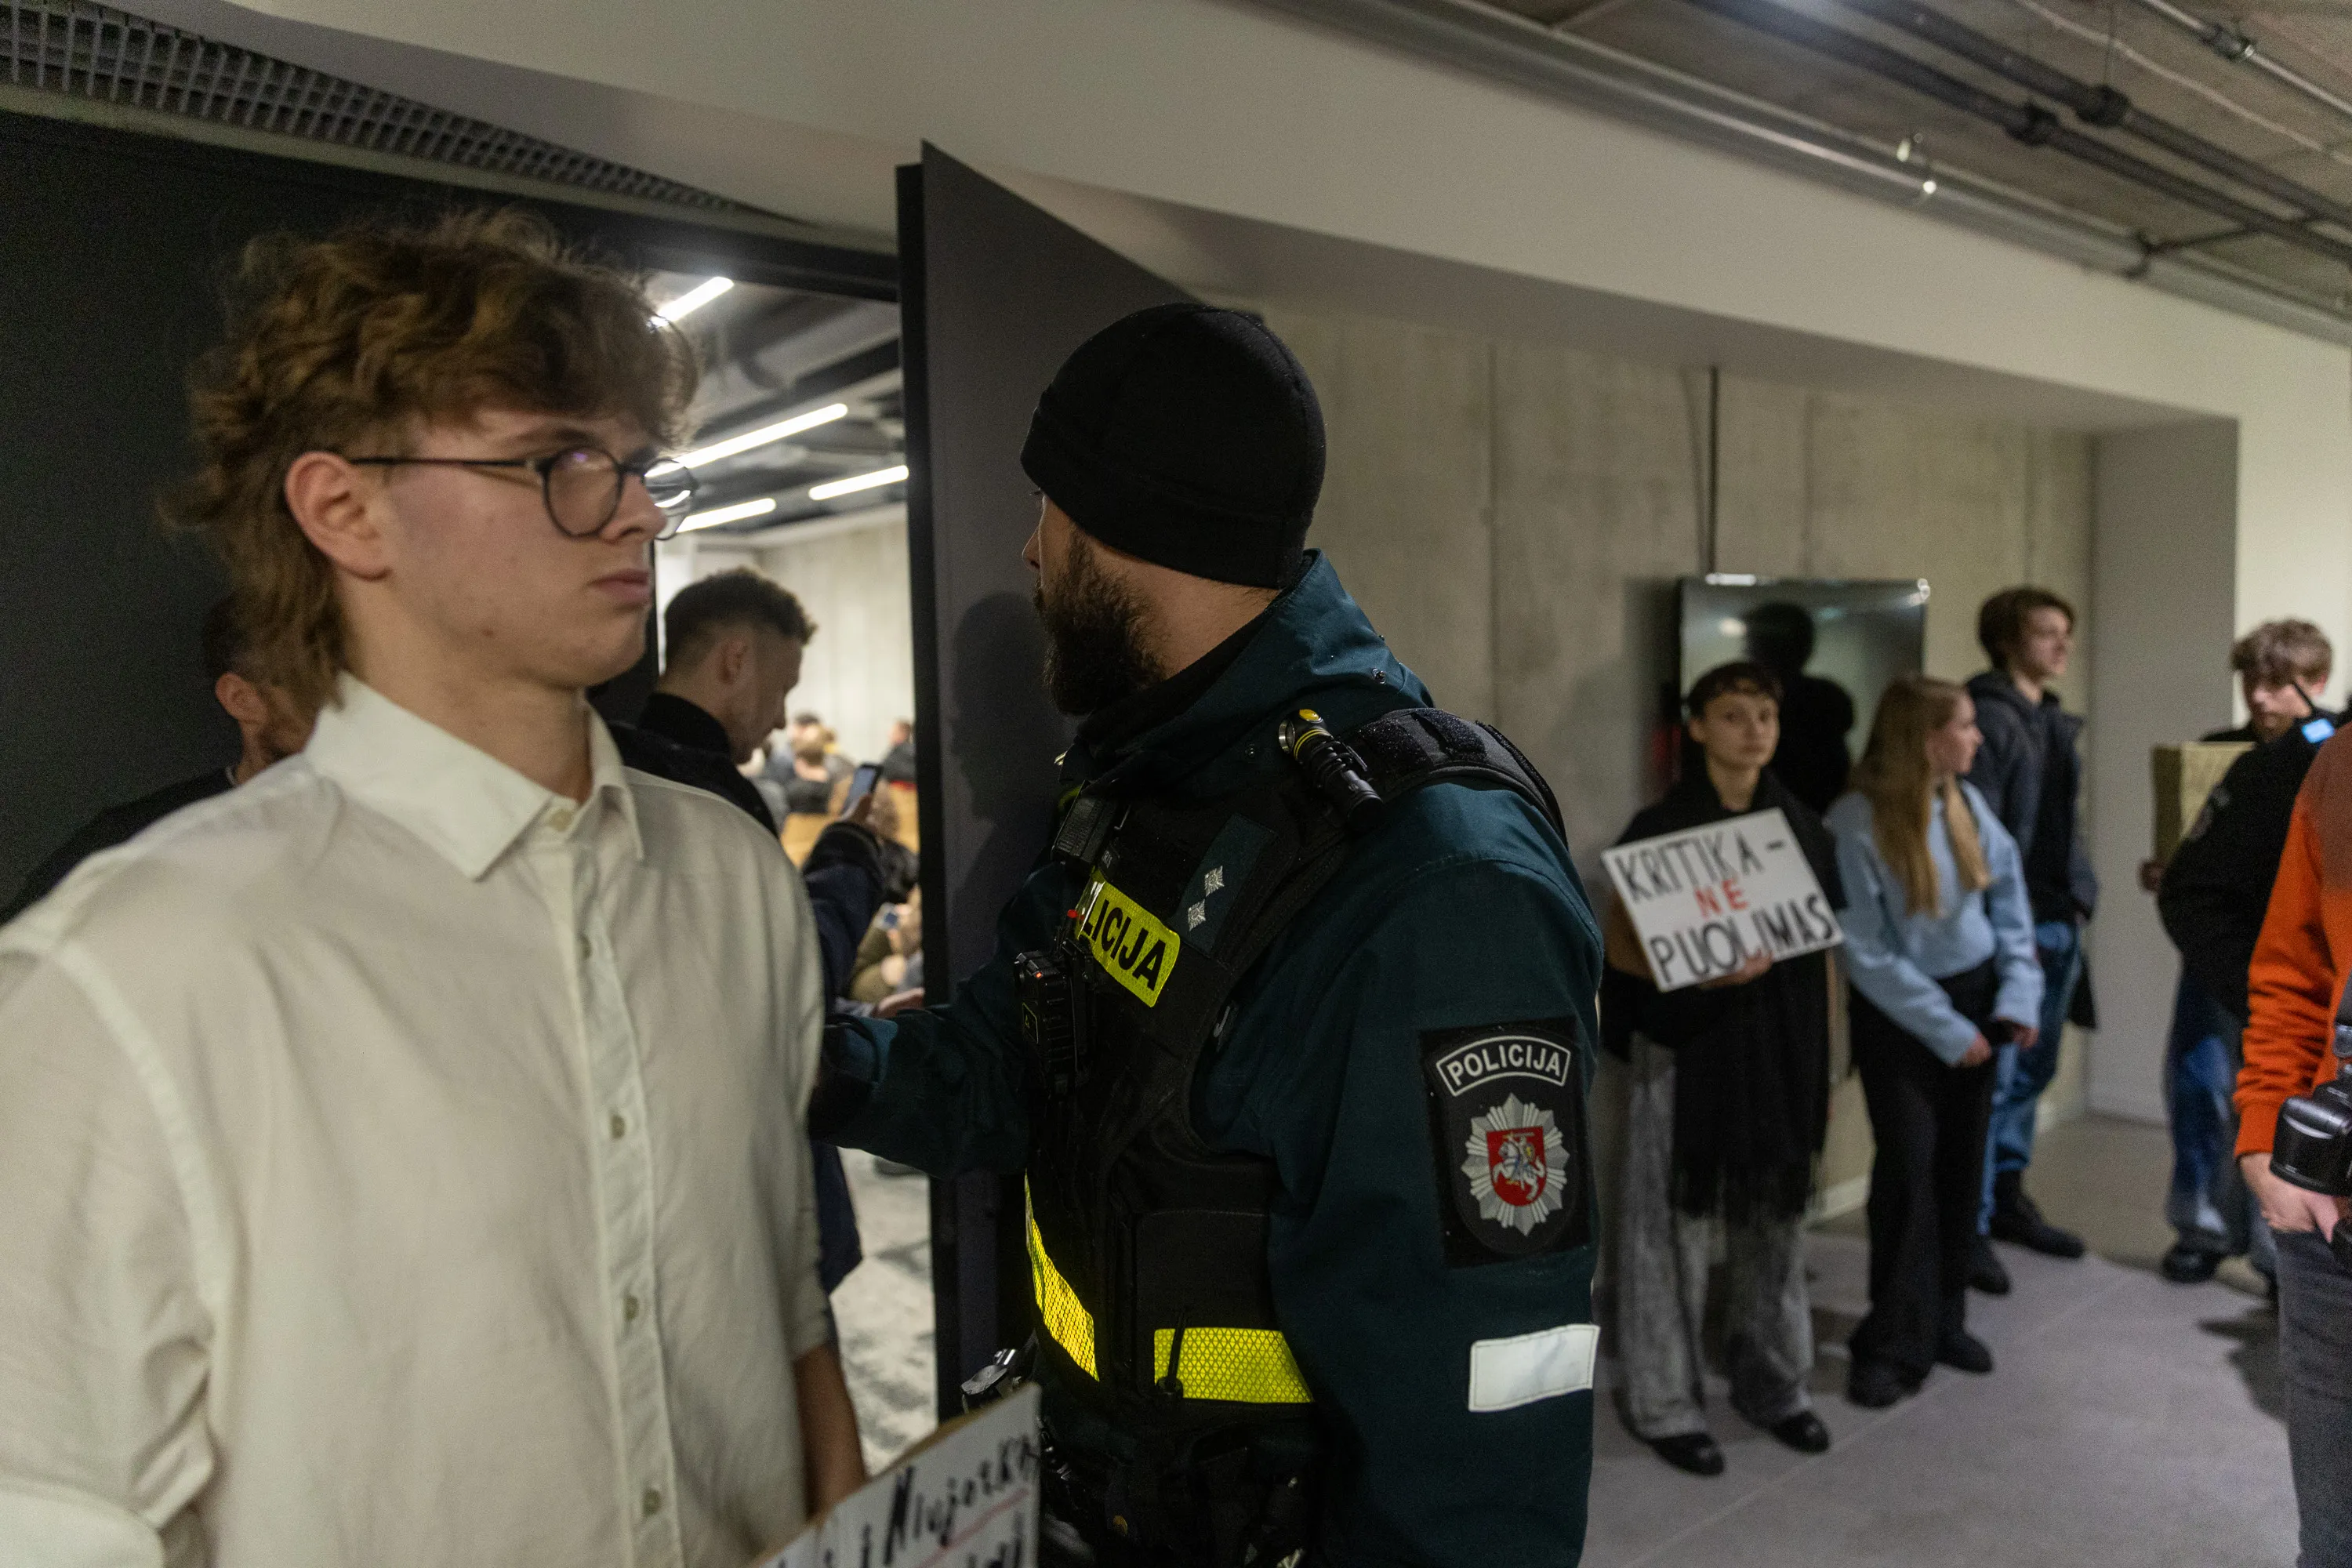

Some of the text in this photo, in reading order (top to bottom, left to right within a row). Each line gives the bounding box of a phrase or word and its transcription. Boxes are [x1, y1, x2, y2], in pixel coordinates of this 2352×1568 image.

[1614, 829, 1763, 903] KRITIKA
[1694, 876, 1749, 918] NE
[1649, 893, 1835, 983] PUOLIMAS
[1446, 1043, 1561, 1087] POLICIJA
